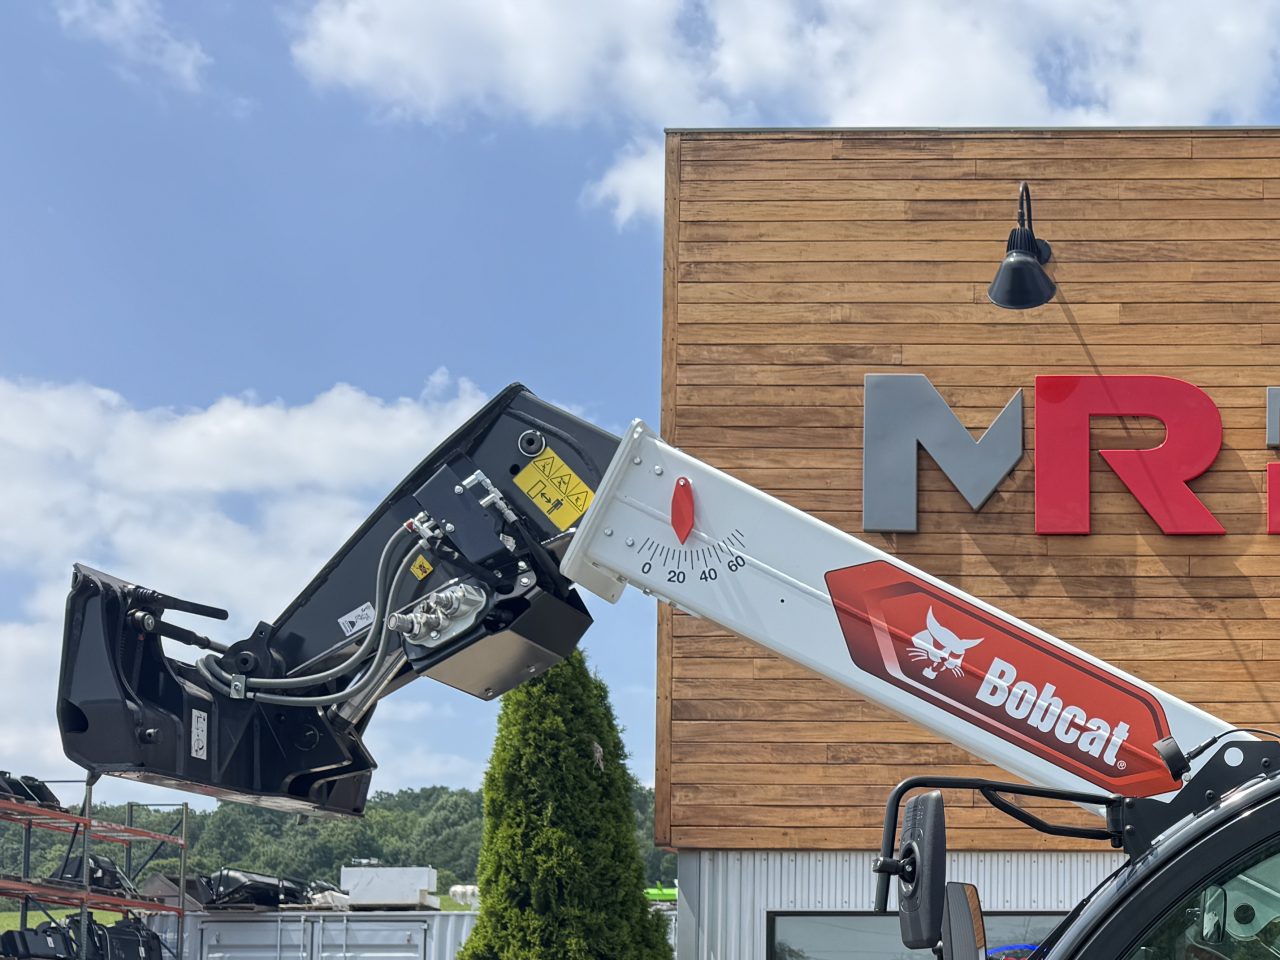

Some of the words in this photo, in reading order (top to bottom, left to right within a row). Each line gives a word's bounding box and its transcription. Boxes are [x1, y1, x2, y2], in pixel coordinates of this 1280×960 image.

[641, 562, 652, 575] 0
[667, 570, 686, 584] 20
[699, 568, 718, 582] 40
[727, 555, 746, 572] 60
[975, 656, 1131, 767] Bobcat
